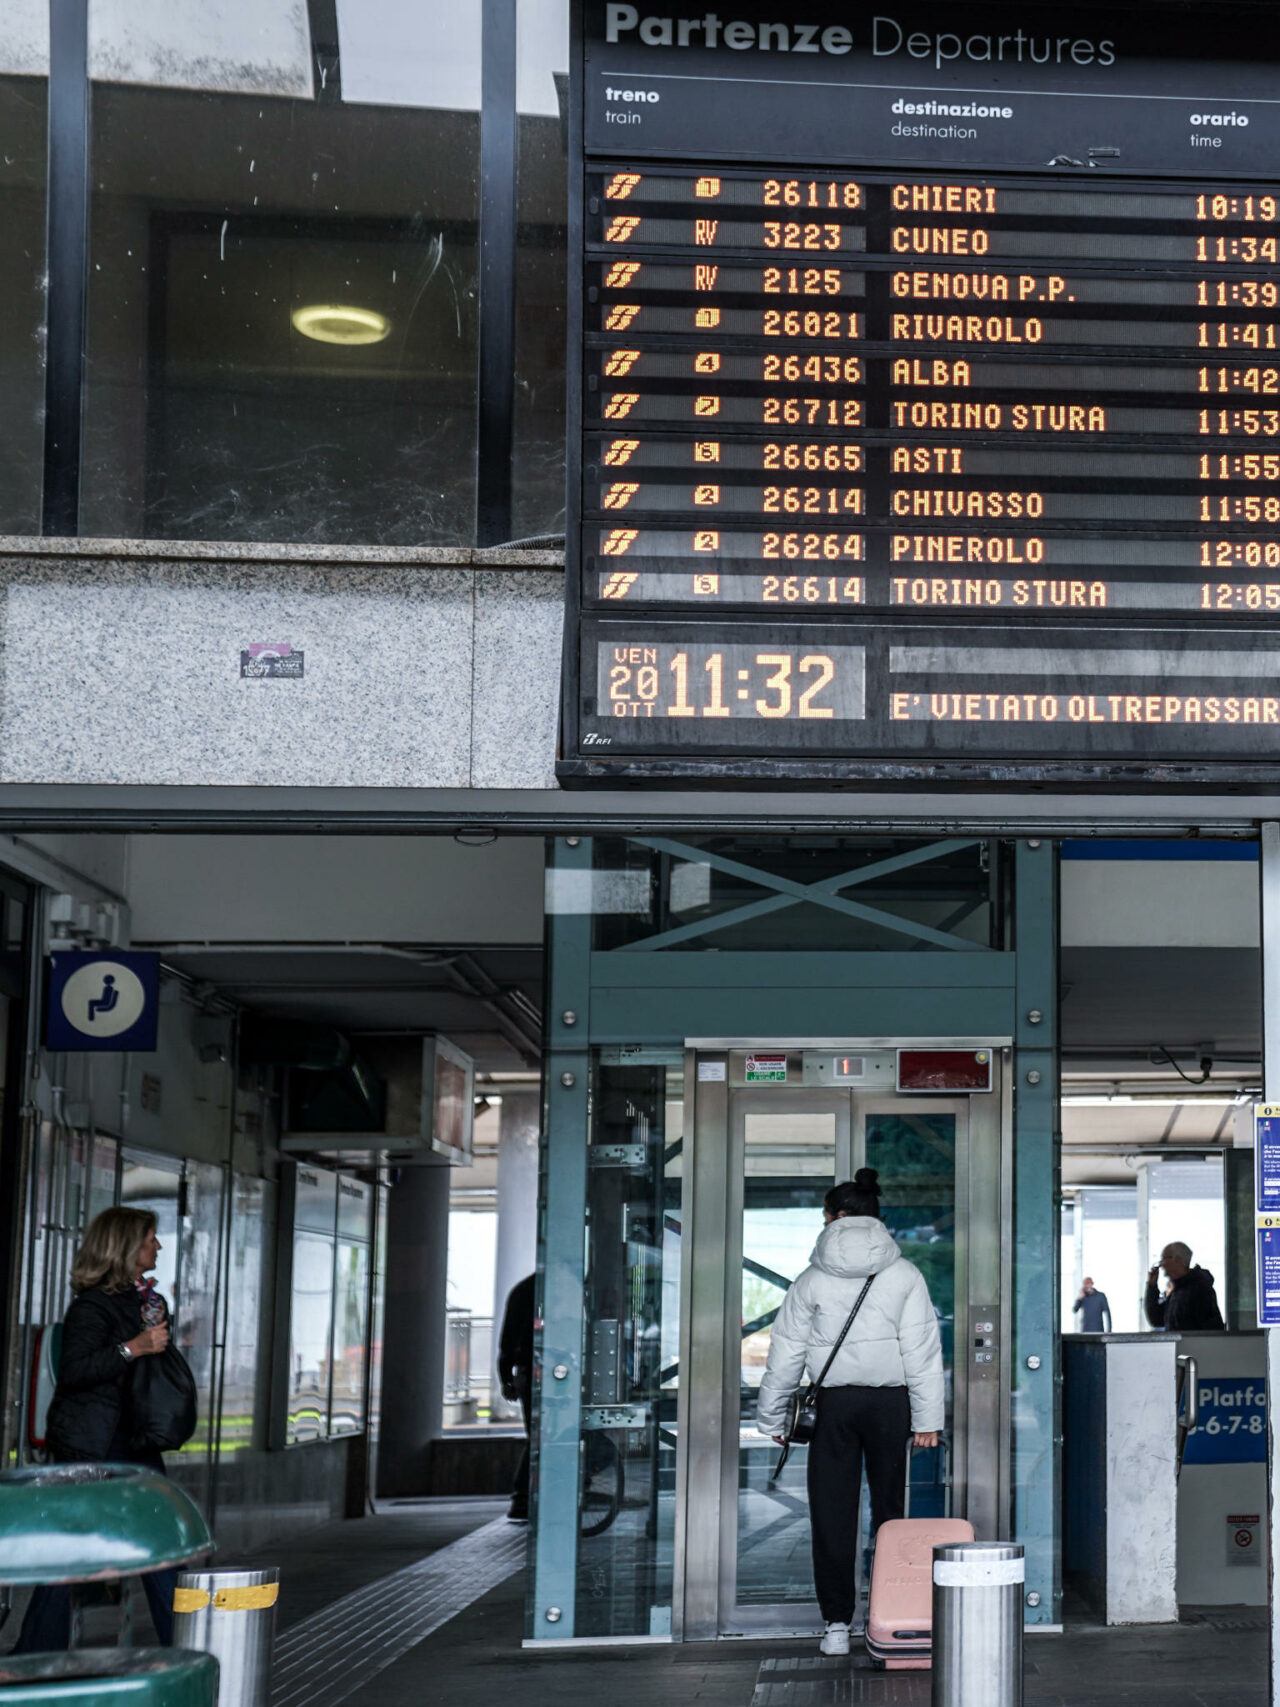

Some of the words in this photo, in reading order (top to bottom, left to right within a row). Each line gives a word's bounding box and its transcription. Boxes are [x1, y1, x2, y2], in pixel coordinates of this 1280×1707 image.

[607, 4, 852, 54] Partenze
[874, 18, 1114, 69] Departures
[606, 88, 659, 103] treno
[892, 99, 1013, 118] destinazione
[606, 111, 641, 124] train
[892, 121, 976, 138] destination
[1190, 112, 1248, 126] orario
[1191, 134, 1221, 147] time
[764, 180, 860, 209] 26118
[893, 185, 996, 213] CHIERI
[1196, 194, 1276, 221] 10:19
[695, 219, 718, 245] RV
[764, 223, 841, 250] 3223
[893, 227, 988, 255] CUNEO
[1196, 236, 1277, 263] 11:34
[695, 265, 718, 291] RV
[764, 267, 841, 295] 2125
[893, 271, 1009, 300] GENOVA
[1019, 275, 1075, 302] P.P.
[1197, 280, 1278, 307] 11:39
[763, 310, 858, 338] 26021
[893, 313, 1042, 343] RIVAROLO
[1198, 322, 1276, 349] 11:41
[763, 354, 861, 383] 26436
[894, 359, 970, 386] ALBA
[1199, 367, 1279, 394] 11:42
[763, 398, 861, 426] 26712
[894, 401, 1001, 429] TORINO
[1012, 404, 1105, 431] STURA
[1199, 409, 1279, 435] 11:53
[763, 443, 861, 471] 26665
[893, 447, 962, 474] ASTI
[1200, 454, 1280, 480] 11:55
[763, 486, 861, 514] 26214
[893, 489, 1043, 518] CHIVASSO
[1200, 496, 1280, 522] 11:58
[762, 532, 861, 560] 26264
[893, 535, 1044, 564] PINEROLO
[1200, 541, 1280, 568] 12:00
[762, 575, 861, 603] 26614
[893, 577, 1002, 606] TORINO
[1012, 579, 1107, 607] STURA
[615, 648, 657, 664] VEN
[610, 665, 658, 700] 20
[667, 653, 834, 718] 11:32
[614, 701, 656, 717] OTT
[893, 693, 920, 720] E'
[931, 694, 1058, 721] VIETATO
[1199, 1386, 1267, 1407] Platfo
